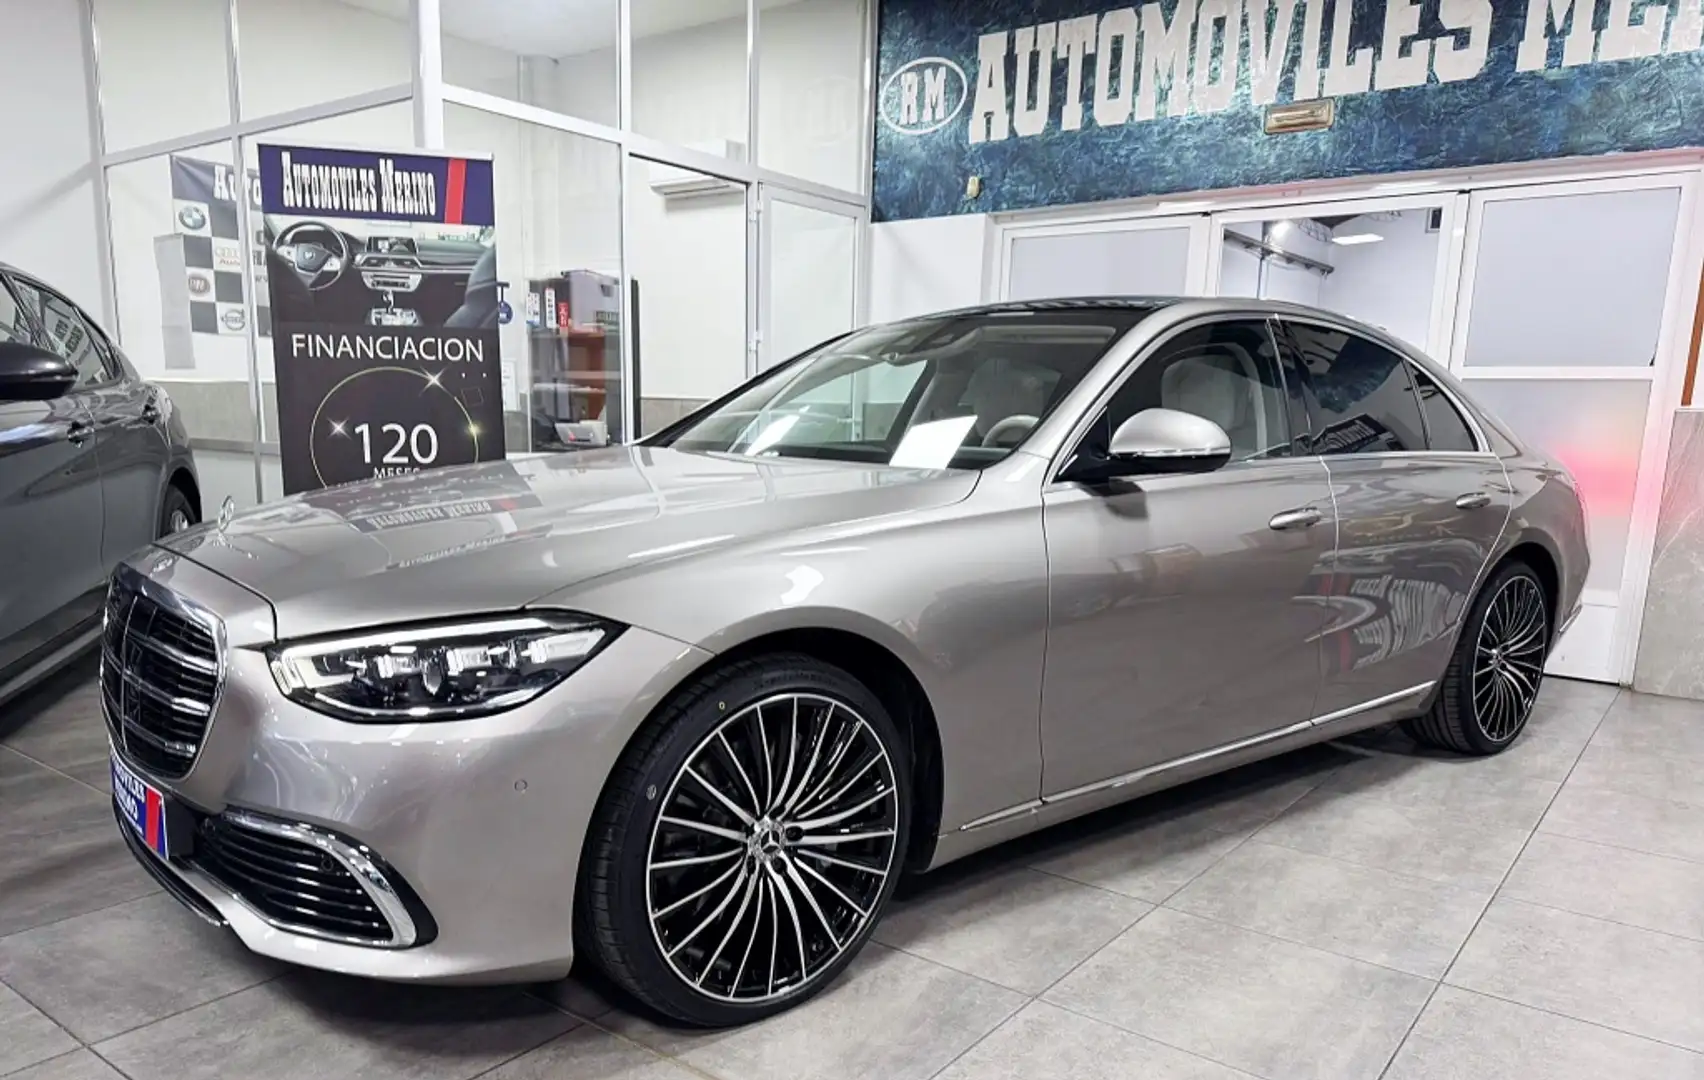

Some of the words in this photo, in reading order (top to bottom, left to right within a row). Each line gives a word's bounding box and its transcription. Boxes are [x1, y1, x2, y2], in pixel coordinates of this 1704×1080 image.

[899, 66, 947, 126] RM
[969, 0, 1491, 143] AUTOMOVILES
[281, 151, 378, 212] AUTOMOVILES
[379, 158, 437, 216] MERINO
[291, 333, 484, 362] FINANCIACION
[354, 423, 439, 464] 120
